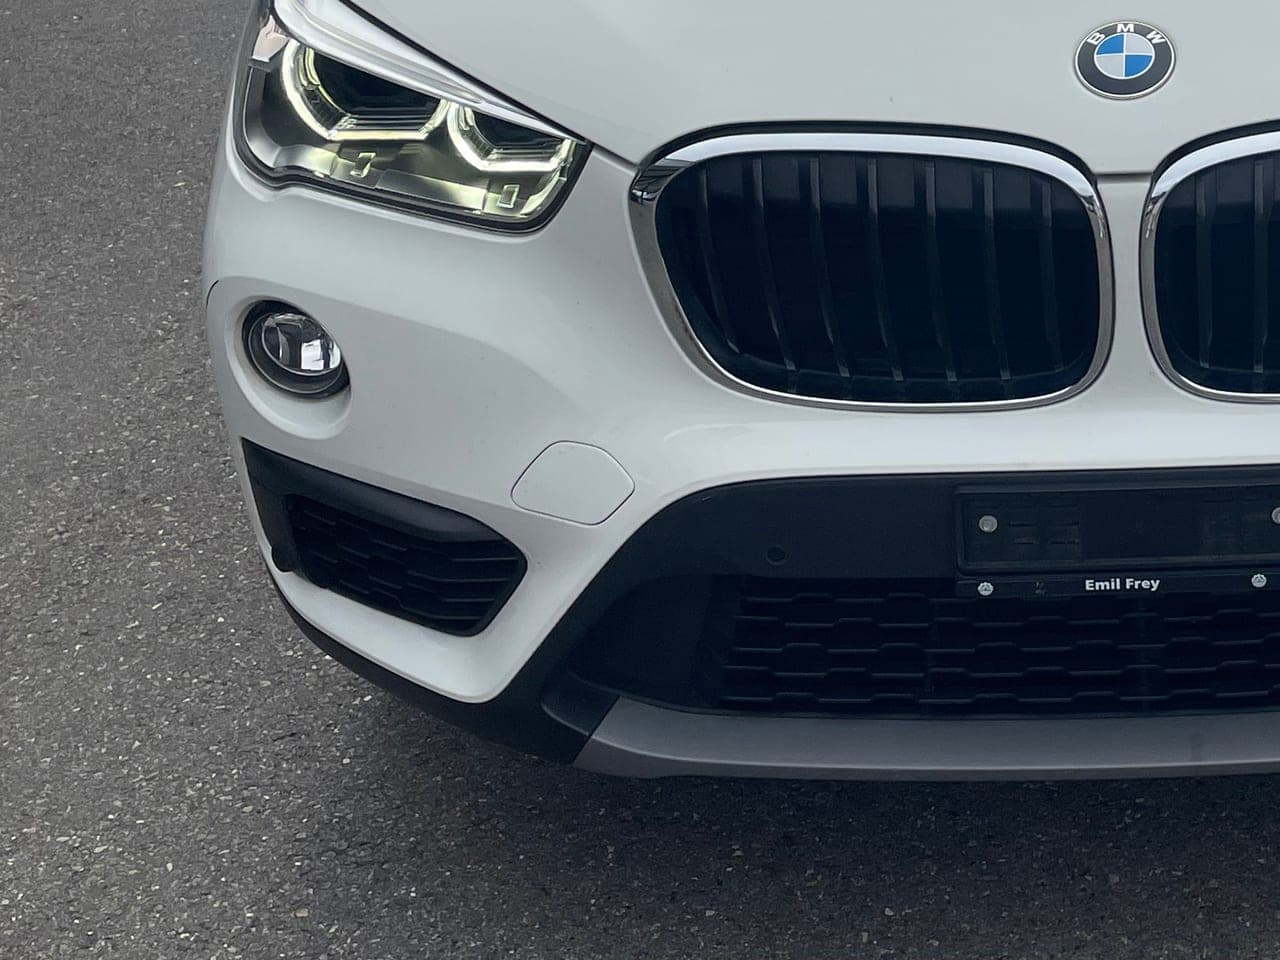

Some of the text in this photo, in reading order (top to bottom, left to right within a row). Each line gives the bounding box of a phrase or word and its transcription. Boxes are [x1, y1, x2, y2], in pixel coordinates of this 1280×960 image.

[1086, 23, 1166, 46] BMW
[1085, 578, 1160, 592] Emil Frey
